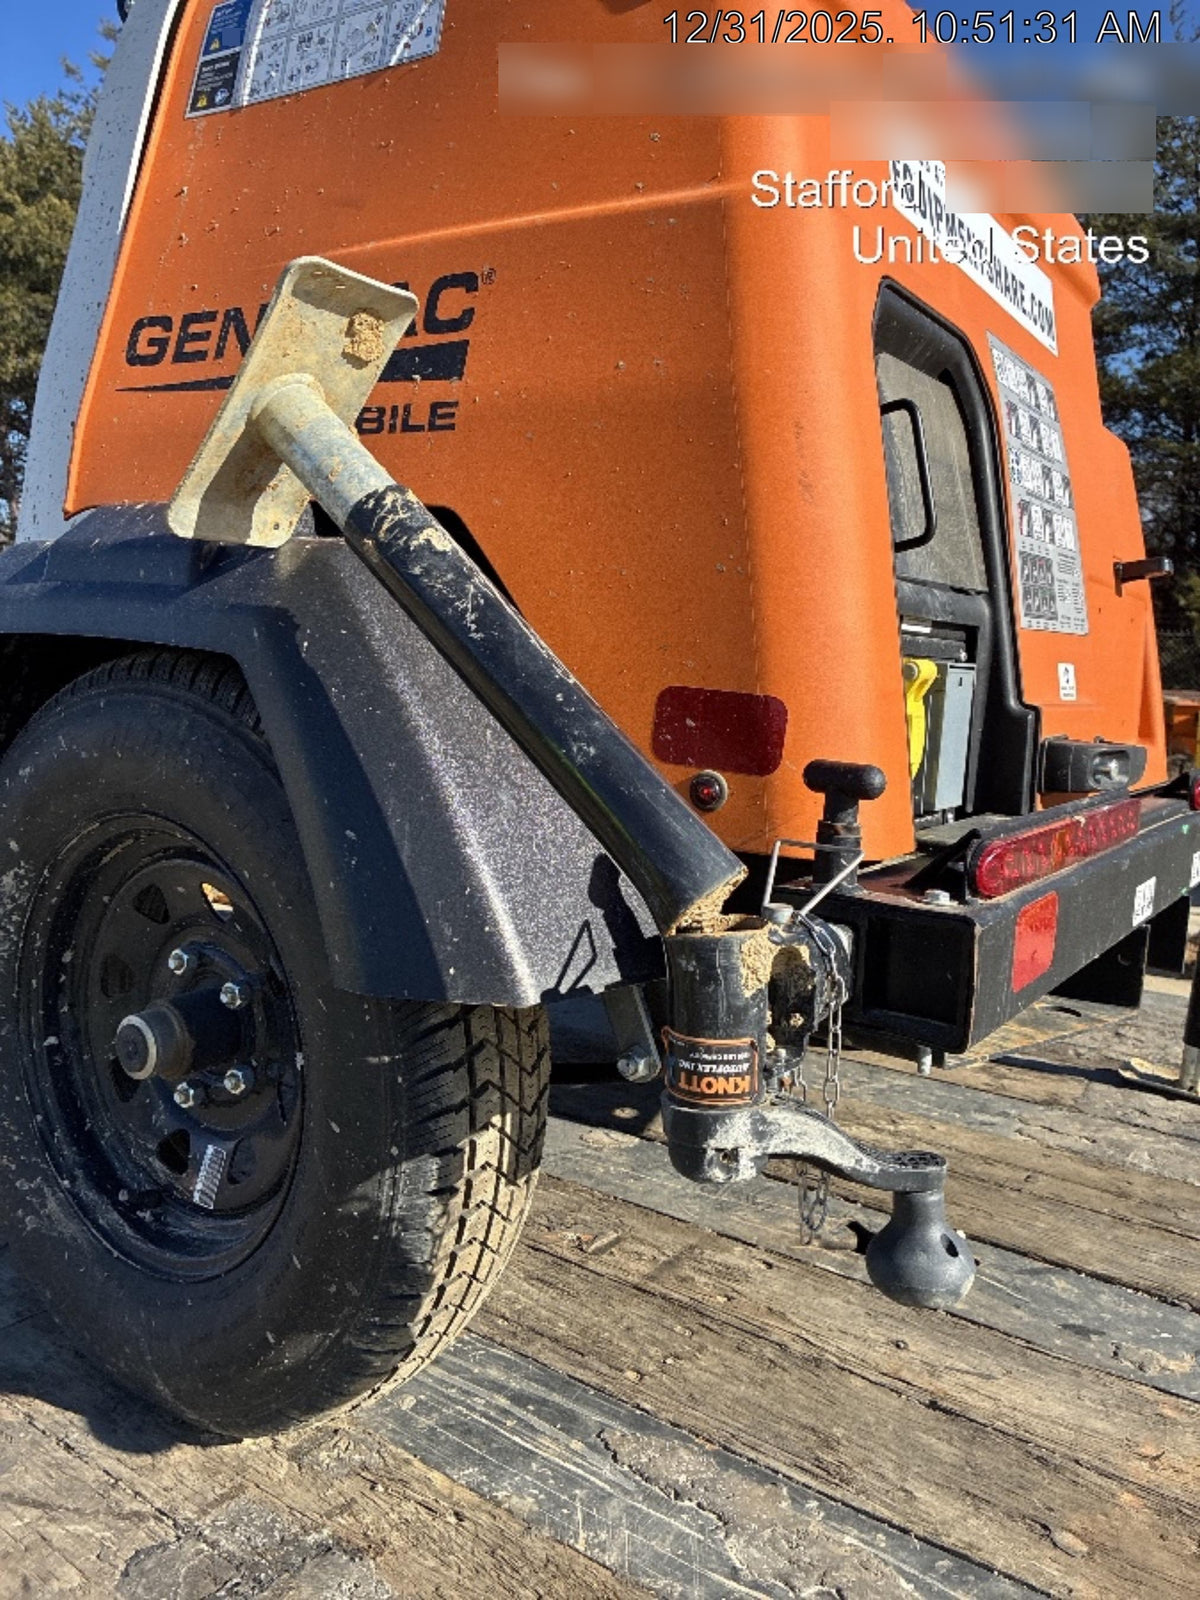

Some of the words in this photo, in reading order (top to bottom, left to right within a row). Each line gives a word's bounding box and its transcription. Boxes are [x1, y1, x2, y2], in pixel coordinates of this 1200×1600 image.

[125, 271, 480, 367] GENC
[355, 400, 458, 434] BILE
[697, 1062, 750, 1074] AUTOFLEX
[679, 1071, 751, 1094] KNOTT
